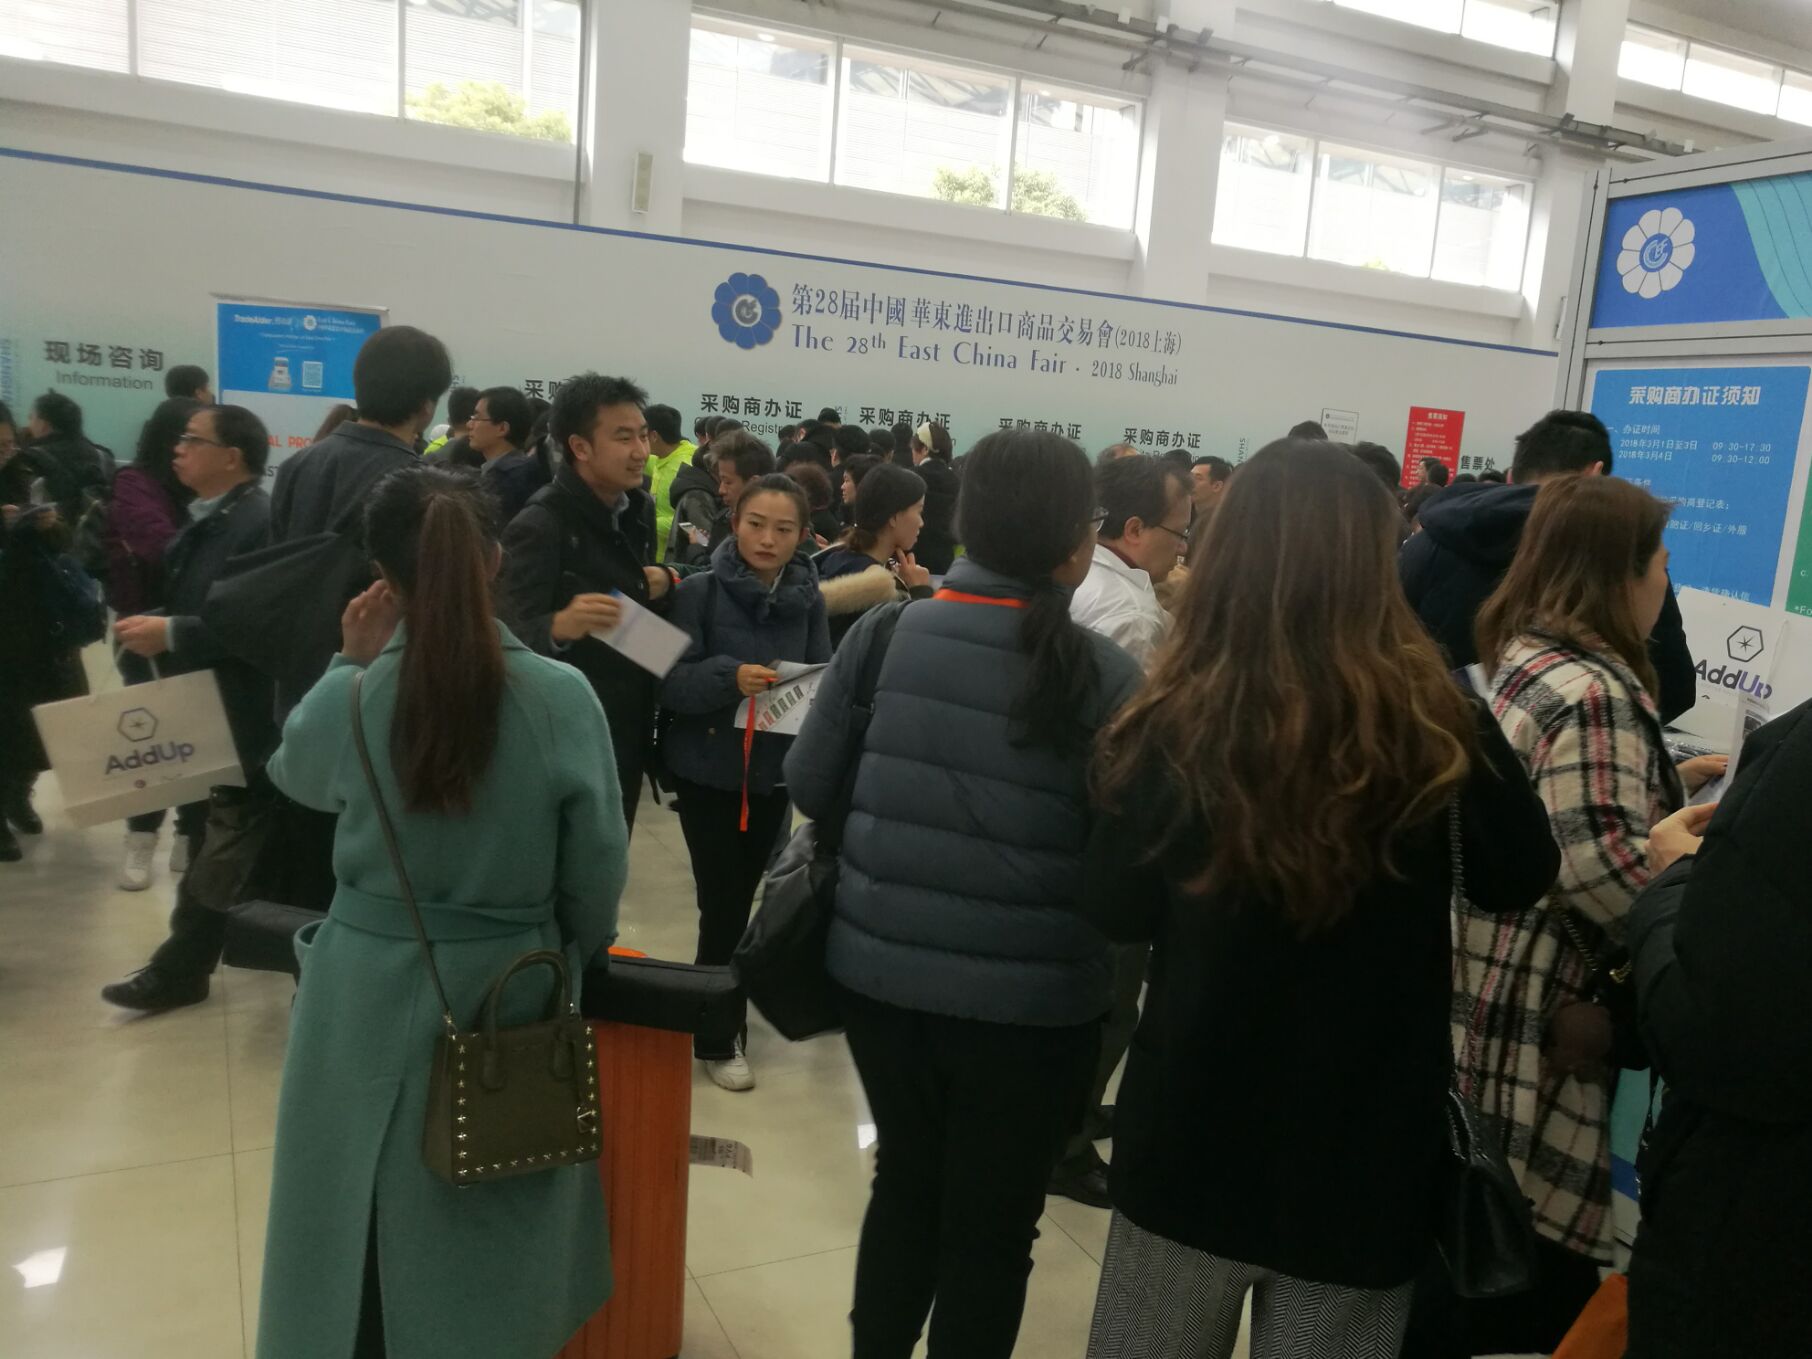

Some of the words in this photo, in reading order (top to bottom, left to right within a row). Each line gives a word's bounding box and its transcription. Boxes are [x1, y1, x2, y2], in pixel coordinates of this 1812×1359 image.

[44, 340, 164, 371] 现场咨询
[792, 324, 834, 351] The
[847, 332, 887, 354] 28th
[898, 335, 941, 362] East
[953, 341, 1017, 369] China
[1030, 349, 1067, 374] Fair
[1091, 359, 1123, 379] 2018
[1127, 361, 1179, 387] Shanghai
[56, 370, 154, 390] Information
[700, 393, 803, 420] 采购商办证
[1628, 385, 1762, 406] 采购商办证须知
[1124, 427, 1202, 449] 采购商办证
[1694, 659, 1773, 699] AddUp
[104, 741, 196, 775] AddUp
